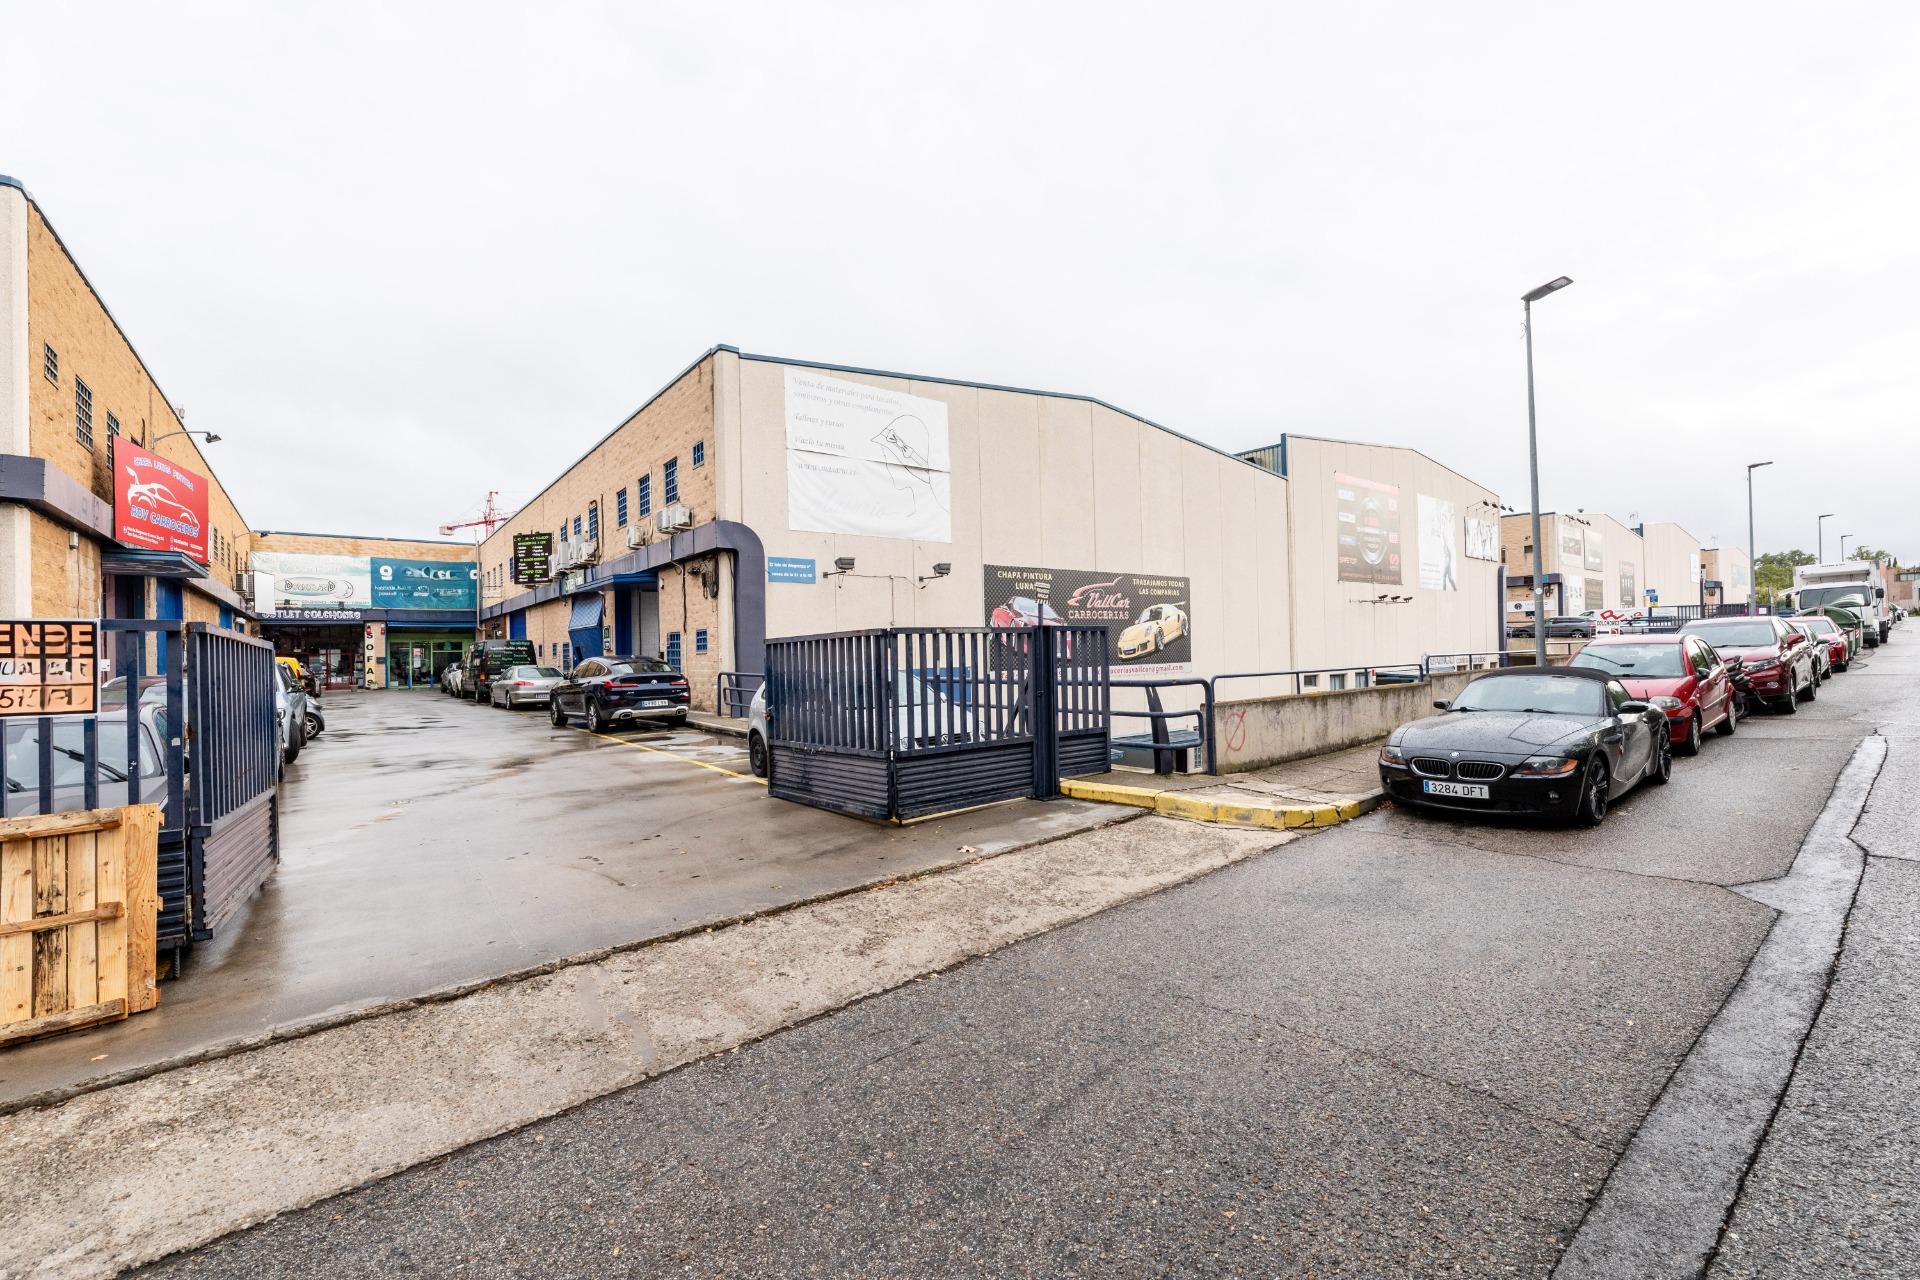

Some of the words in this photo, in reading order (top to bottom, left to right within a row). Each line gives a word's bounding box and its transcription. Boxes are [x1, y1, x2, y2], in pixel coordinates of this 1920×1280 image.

[997, 570, 1021, 579] CHAPA
[1023, 572, 1053, 581] PINTURA
[1015, 582, 1037, 590] LUNA
[1133, 578, 1168, 587] TRABAJAMOS
[1168, 579, 1185, 588] TODAS
[1086, 592, 1131, 609] VallCar
[1067, 610, 1130, 620] CARROCERIAS
[1431, 782, 1458, 795] 3284
[1462, 785, 1485, 797] DFT
